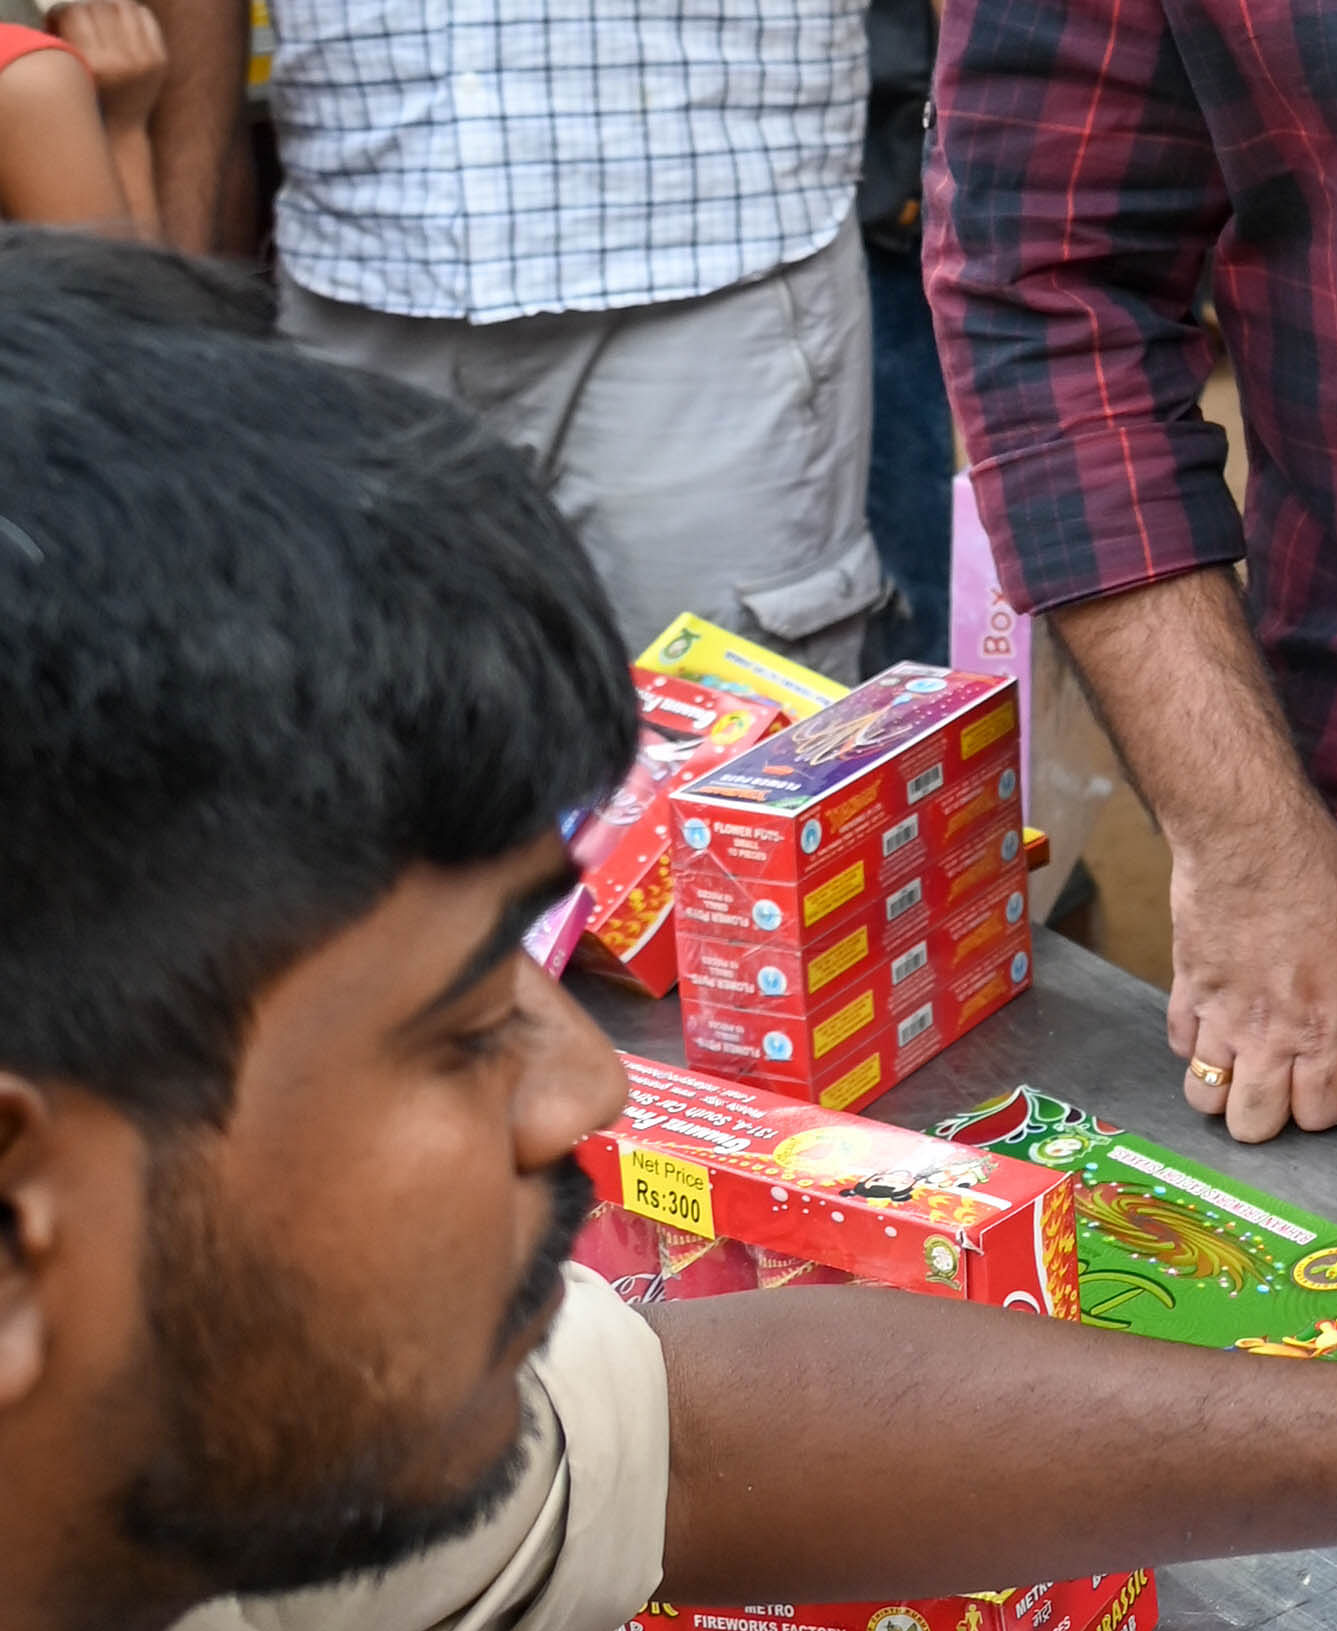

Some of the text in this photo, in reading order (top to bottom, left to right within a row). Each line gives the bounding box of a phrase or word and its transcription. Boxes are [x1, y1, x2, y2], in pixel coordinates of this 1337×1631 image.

[631, 1150, 705, 1191] Net Price
[636, 1179, 702, 1224] Rs:300
